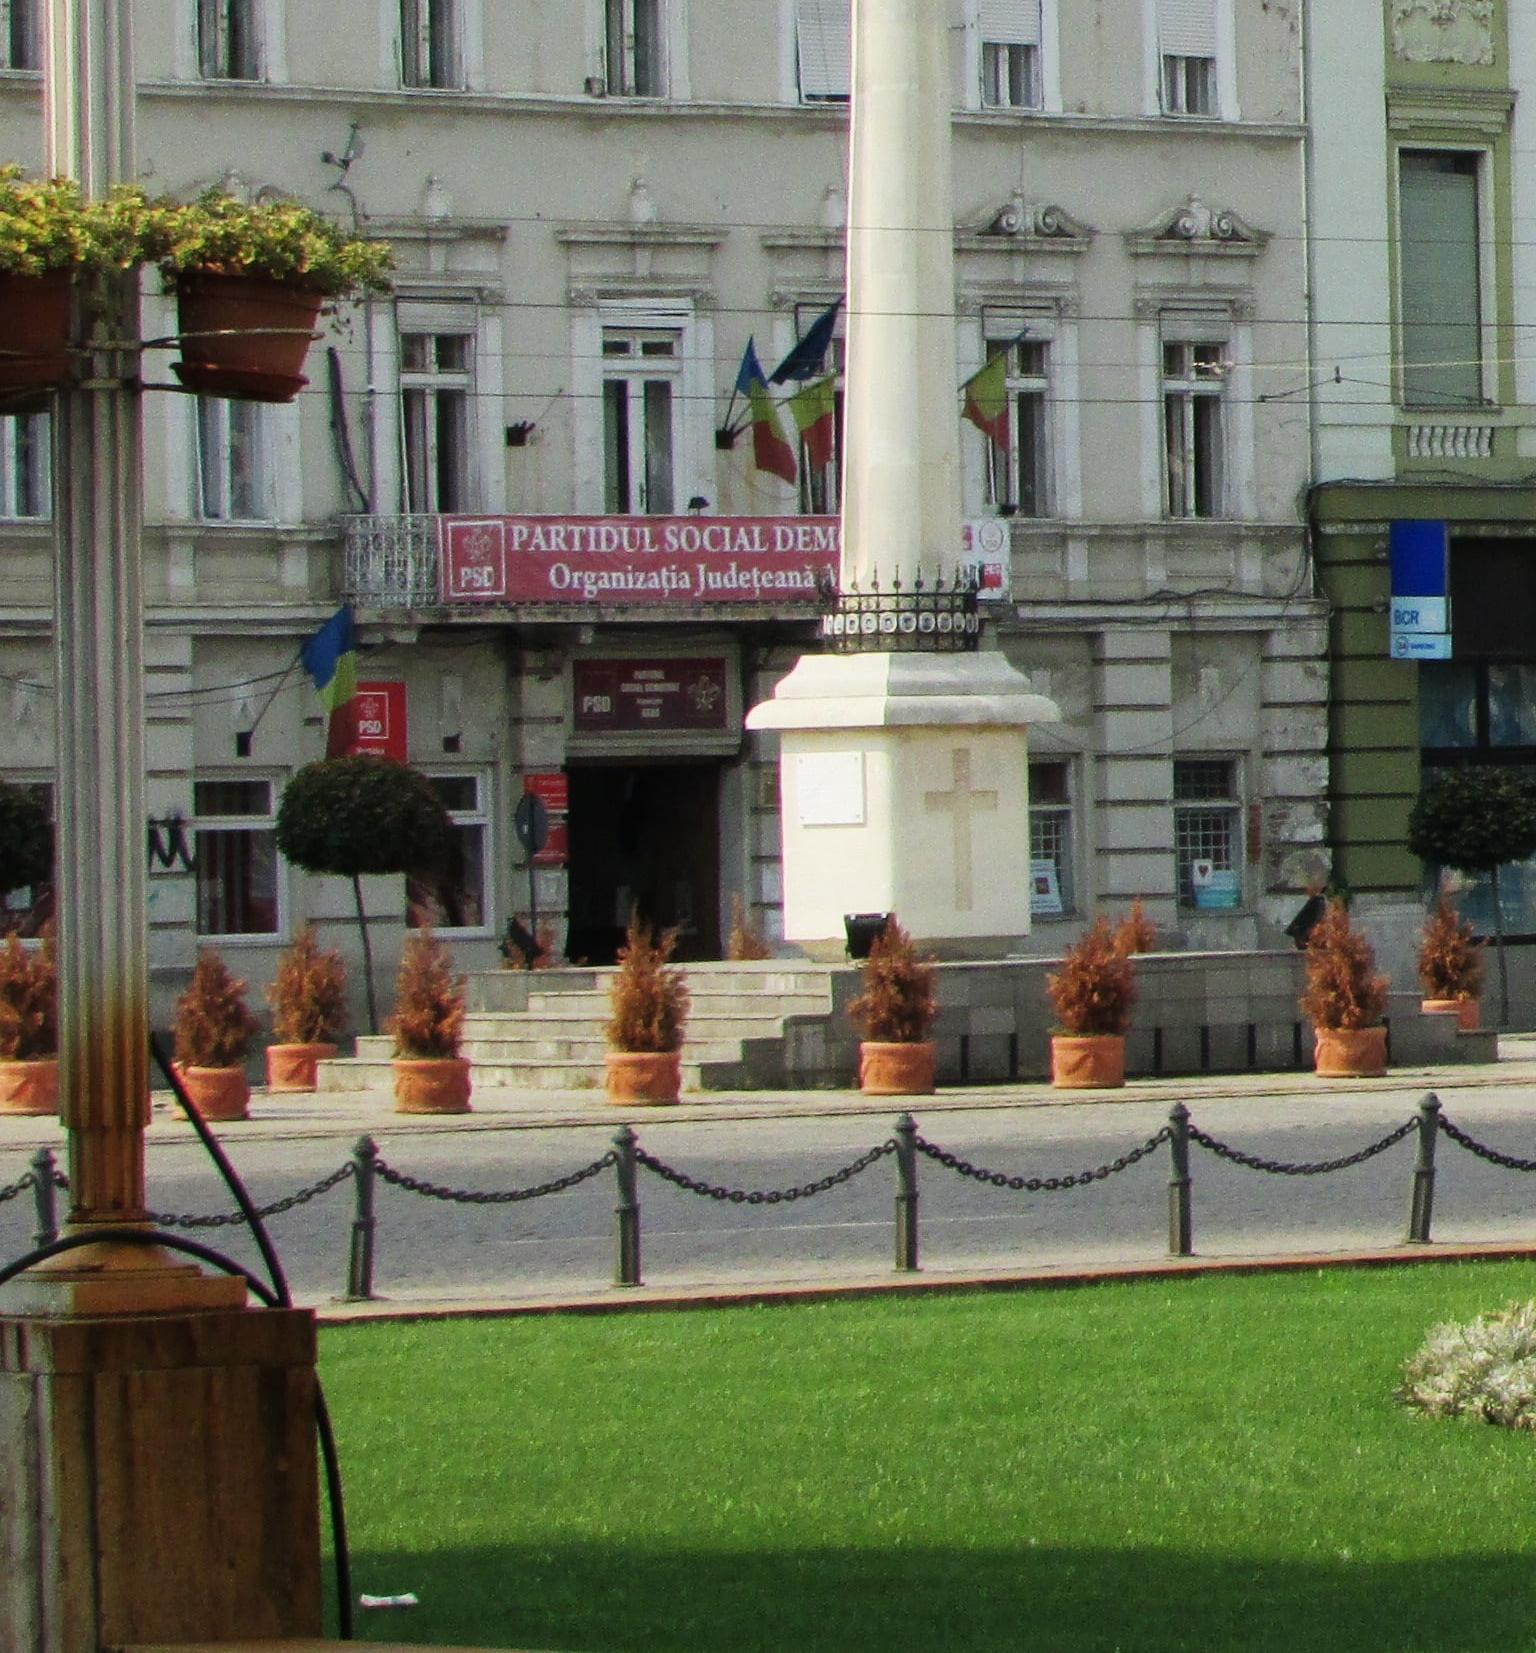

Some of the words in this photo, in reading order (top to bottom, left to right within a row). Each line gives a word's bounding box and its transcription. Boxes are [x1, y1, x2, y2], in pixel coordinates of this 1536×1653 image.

[511, 524, 658, 552] PARTIDUL
[664, 524, 769, 553] SOCIAL
[773, 525, 839, 552] DEM
[461, 566, 494, 588] PSD
[549, 562, 692, 598] Organizația
[694, 561, 817, 597] Județeană
[1394, 609, 1419, 625] BCR
[583, 695, 612, 713] PSD
